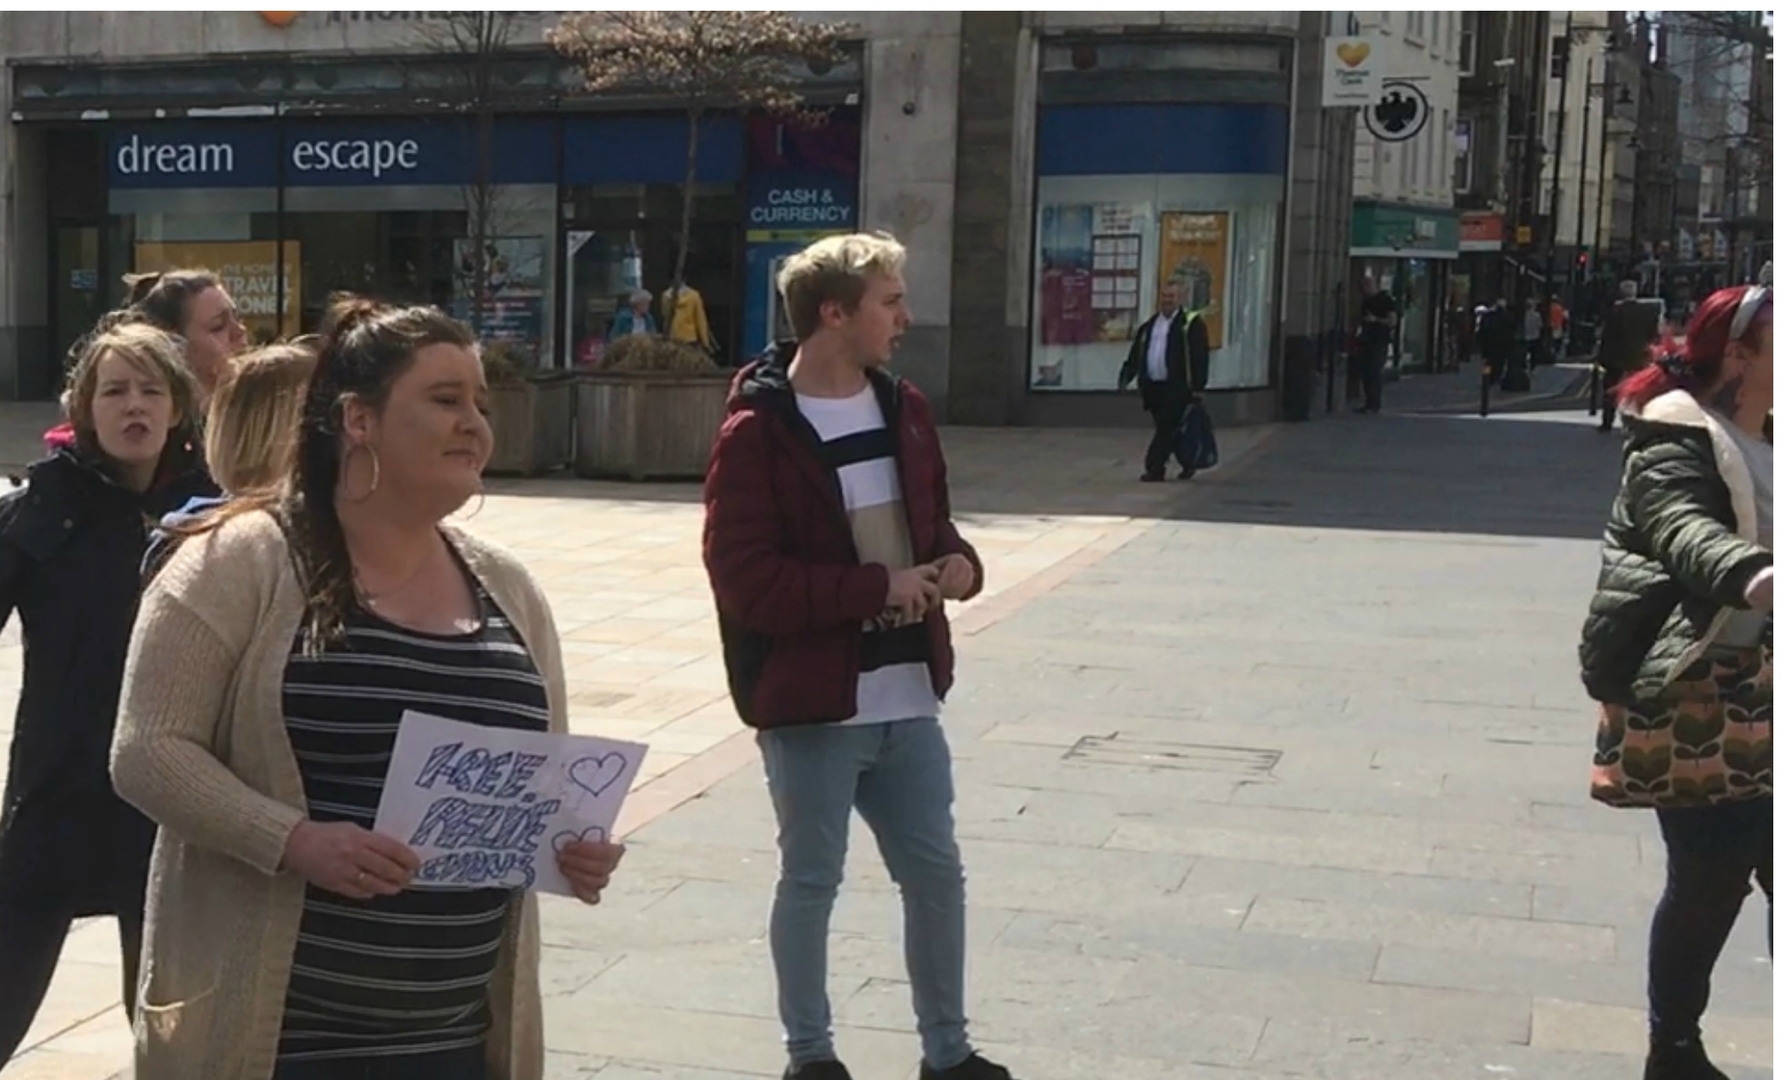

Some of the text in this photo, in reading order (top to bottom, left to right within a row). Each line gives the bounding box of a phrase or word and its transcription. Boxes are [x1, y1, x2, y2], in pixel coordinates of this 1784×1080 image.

[118, 134, 419, 178] dream escape
[768, 189, 833, 204] CASH &
[751, 206, 850, 222] CURRENCY
[223, 276, 293, 294] TRAVEL
[233, 294, 292, 315] ONEY
